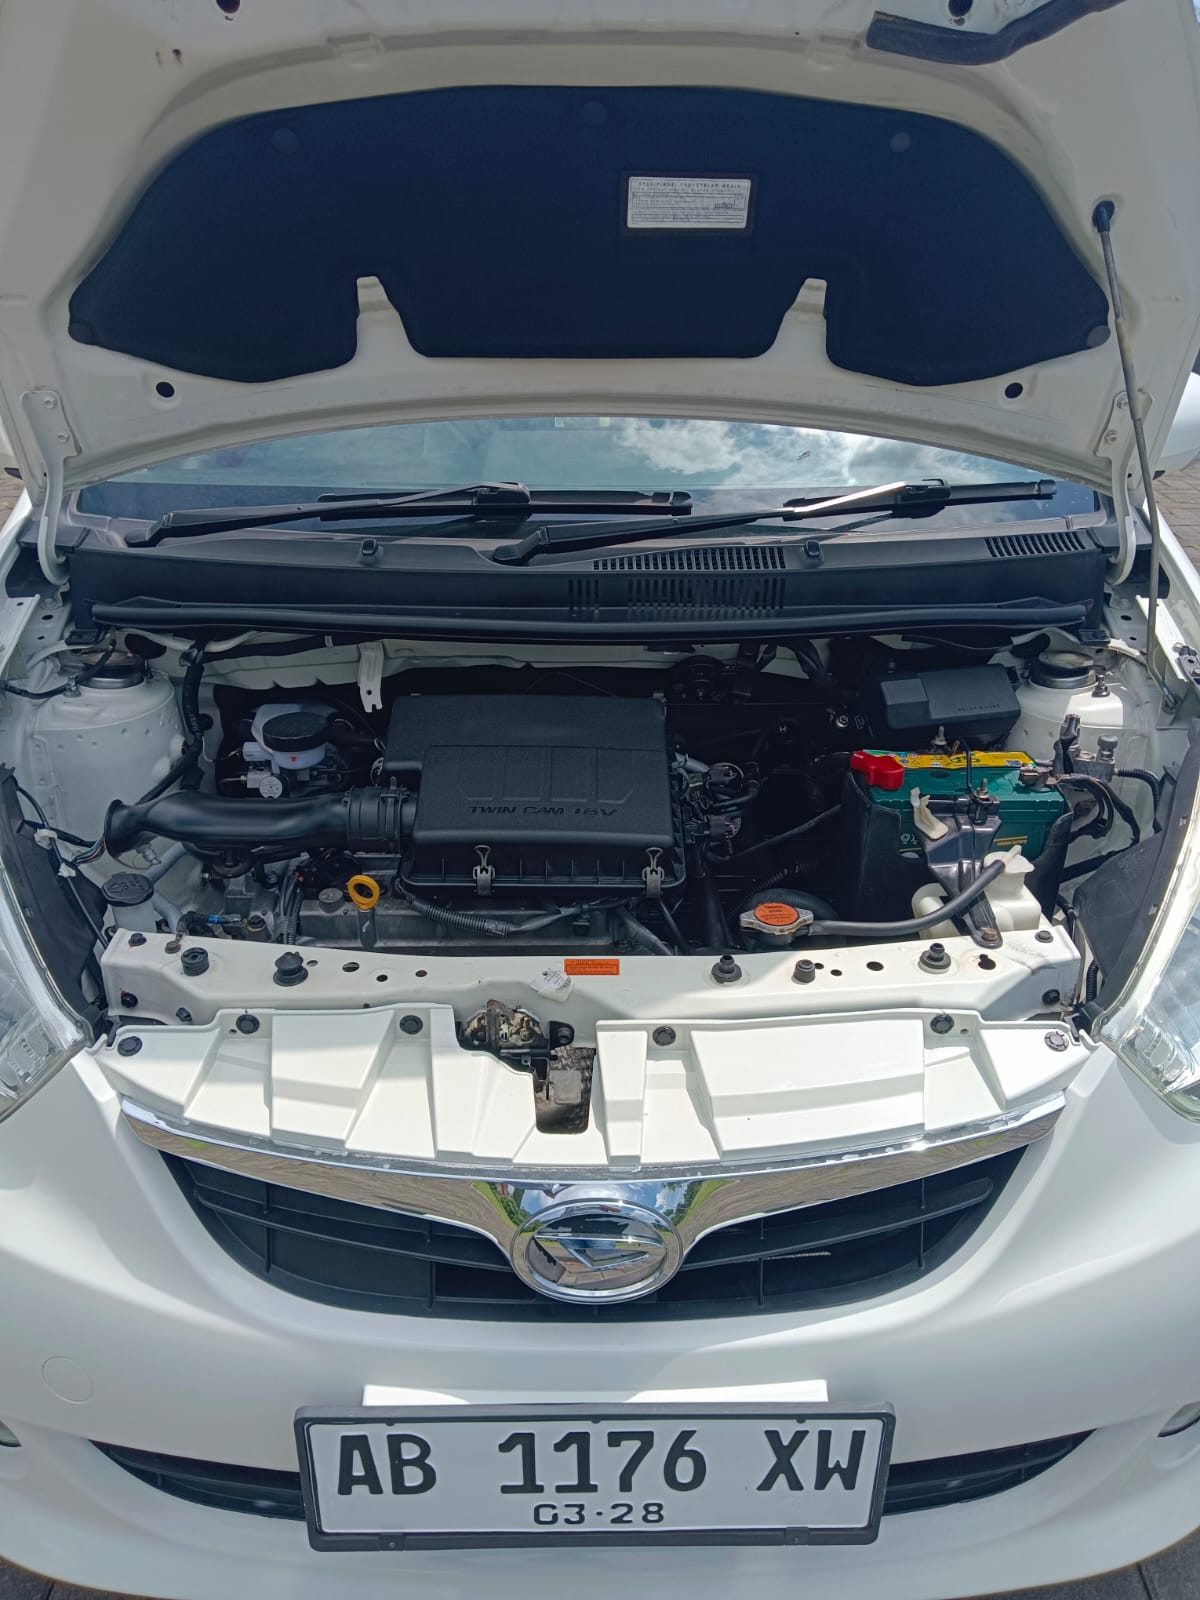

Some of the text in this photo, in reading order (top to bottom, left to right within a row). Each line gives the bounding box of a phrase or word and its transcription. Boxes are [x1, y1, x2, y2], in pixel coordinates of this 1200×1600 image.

[468, 805, 618, 817] TWIN CAM 16V
[337, 1428, 867, 1496] AB 1176 XW
